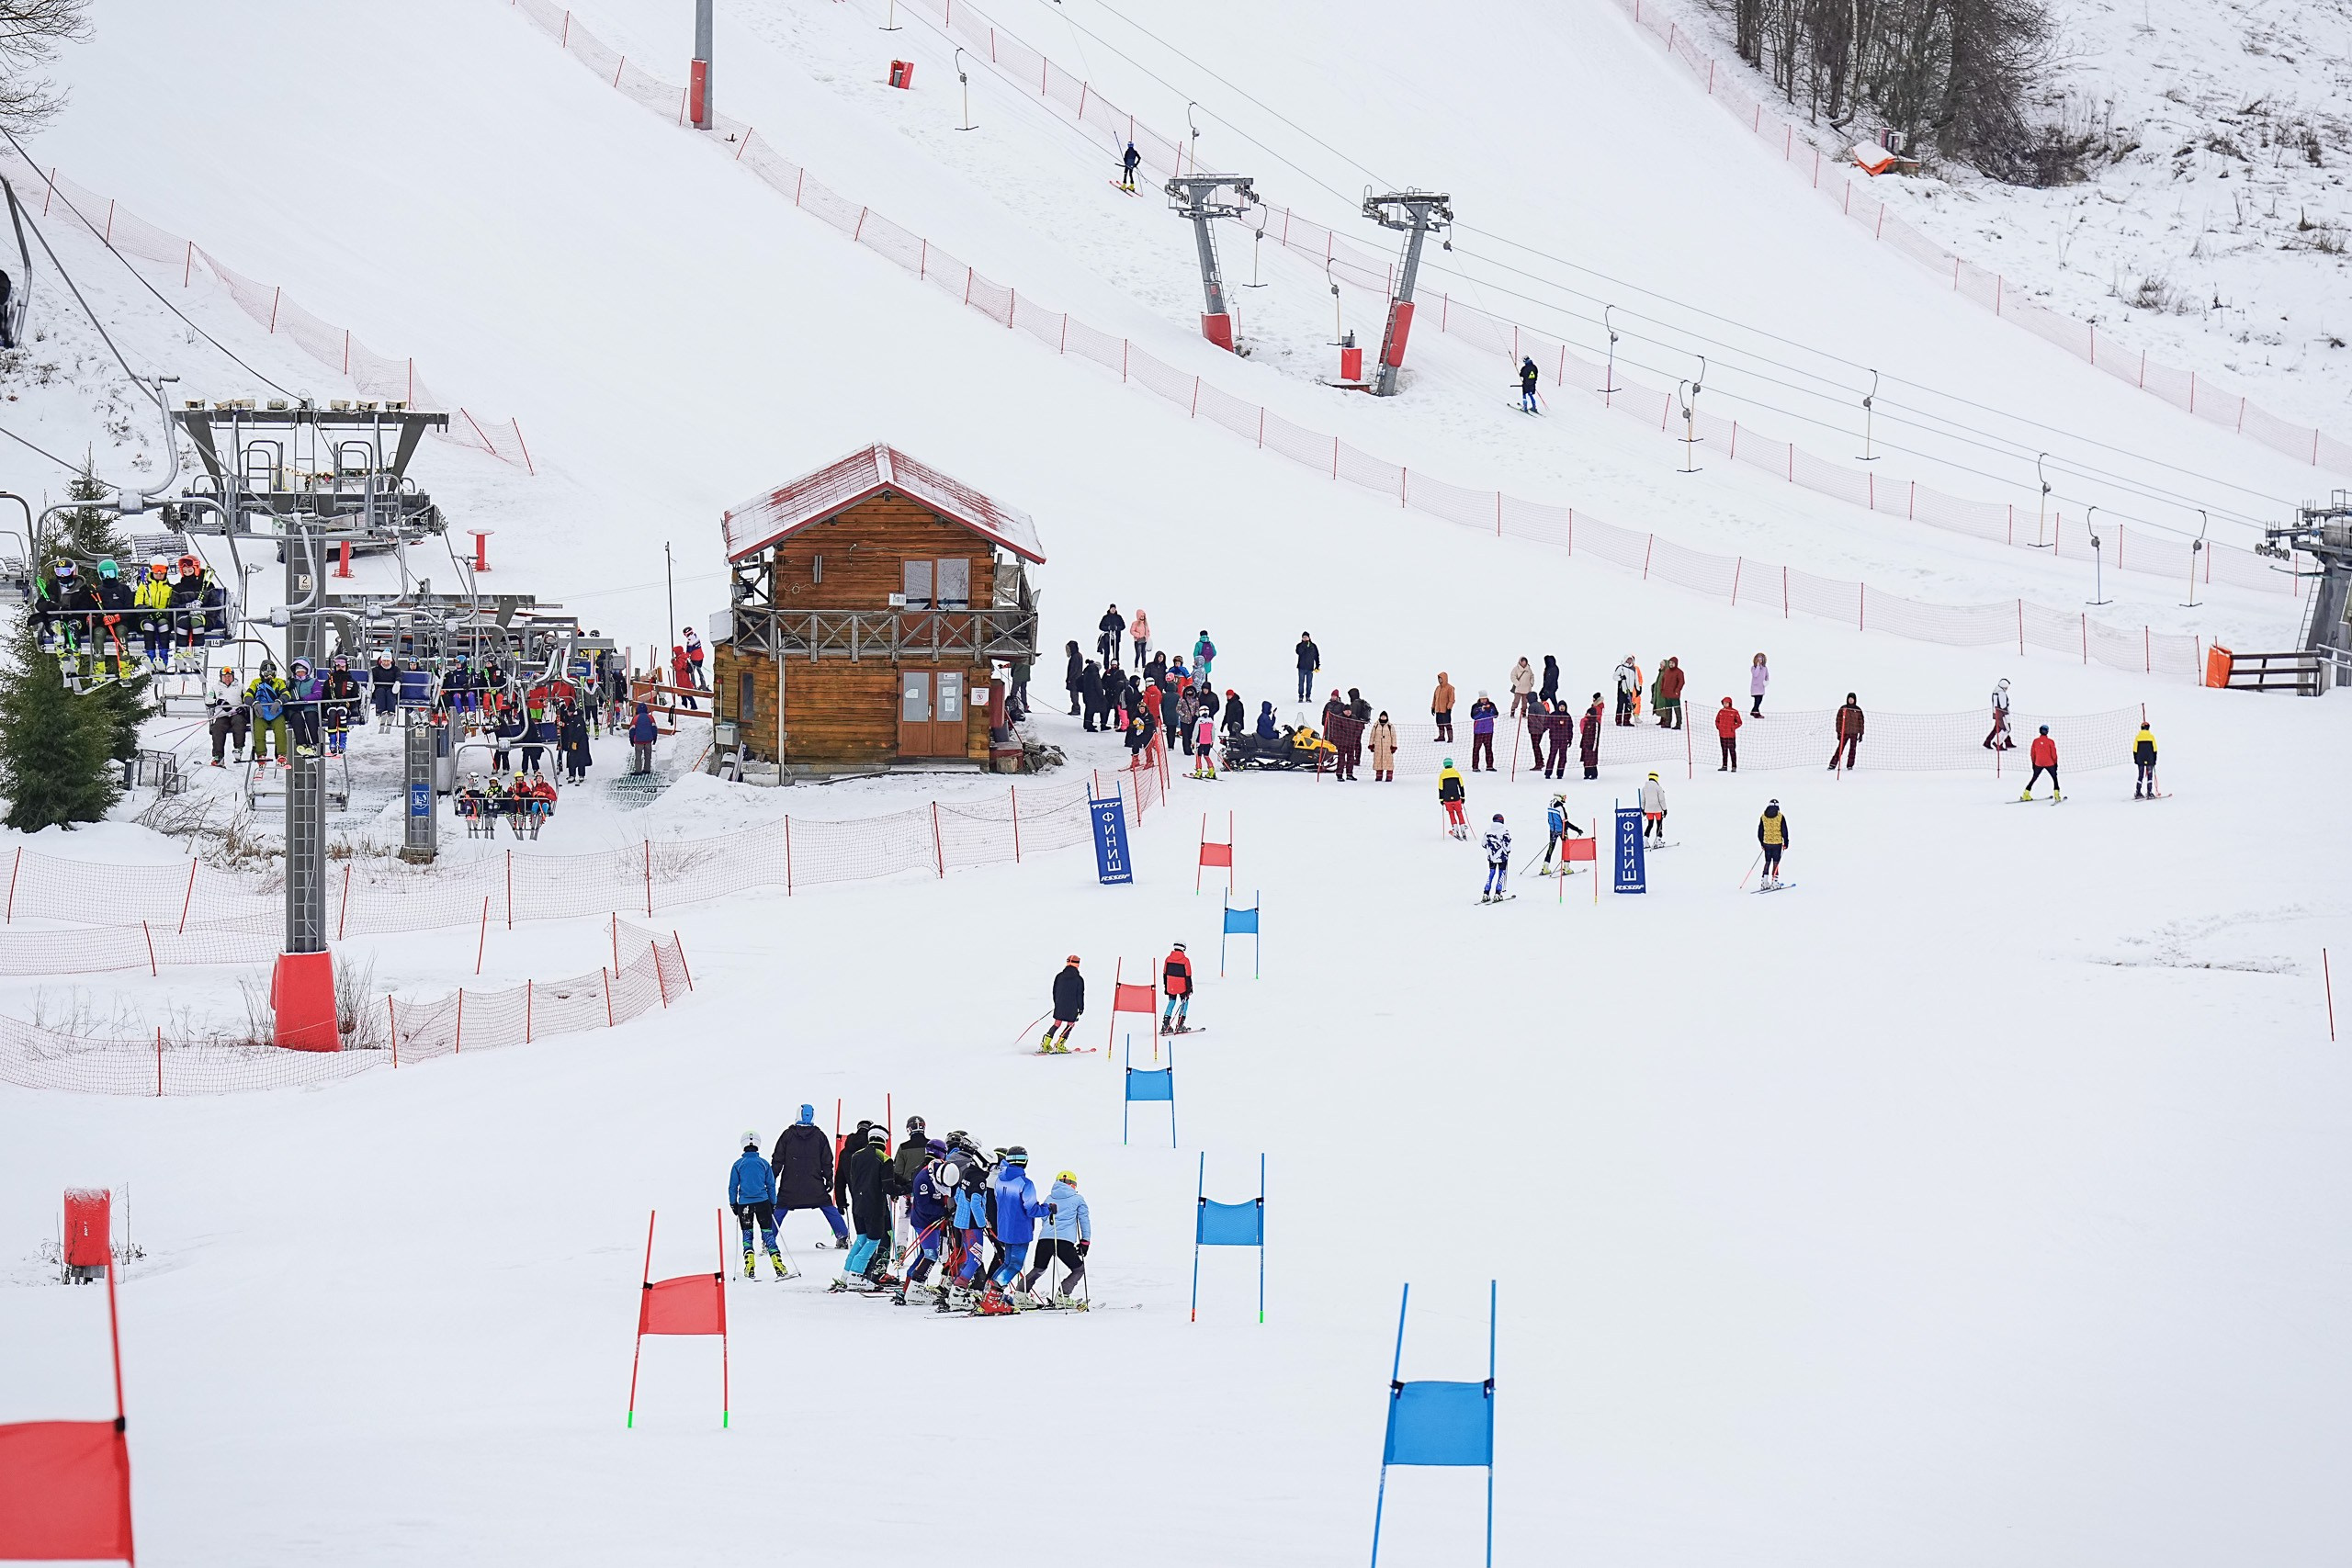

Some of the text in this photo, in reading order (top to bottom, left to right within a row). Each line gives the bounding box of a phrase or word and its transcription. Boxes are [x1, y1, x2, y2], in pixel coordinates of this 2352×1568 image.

[302, 575, 308, 584] 2
[1102, 812, 1122, 872] ФИНИШ
[1623, 821, 1637, 881] ФИНИШ
